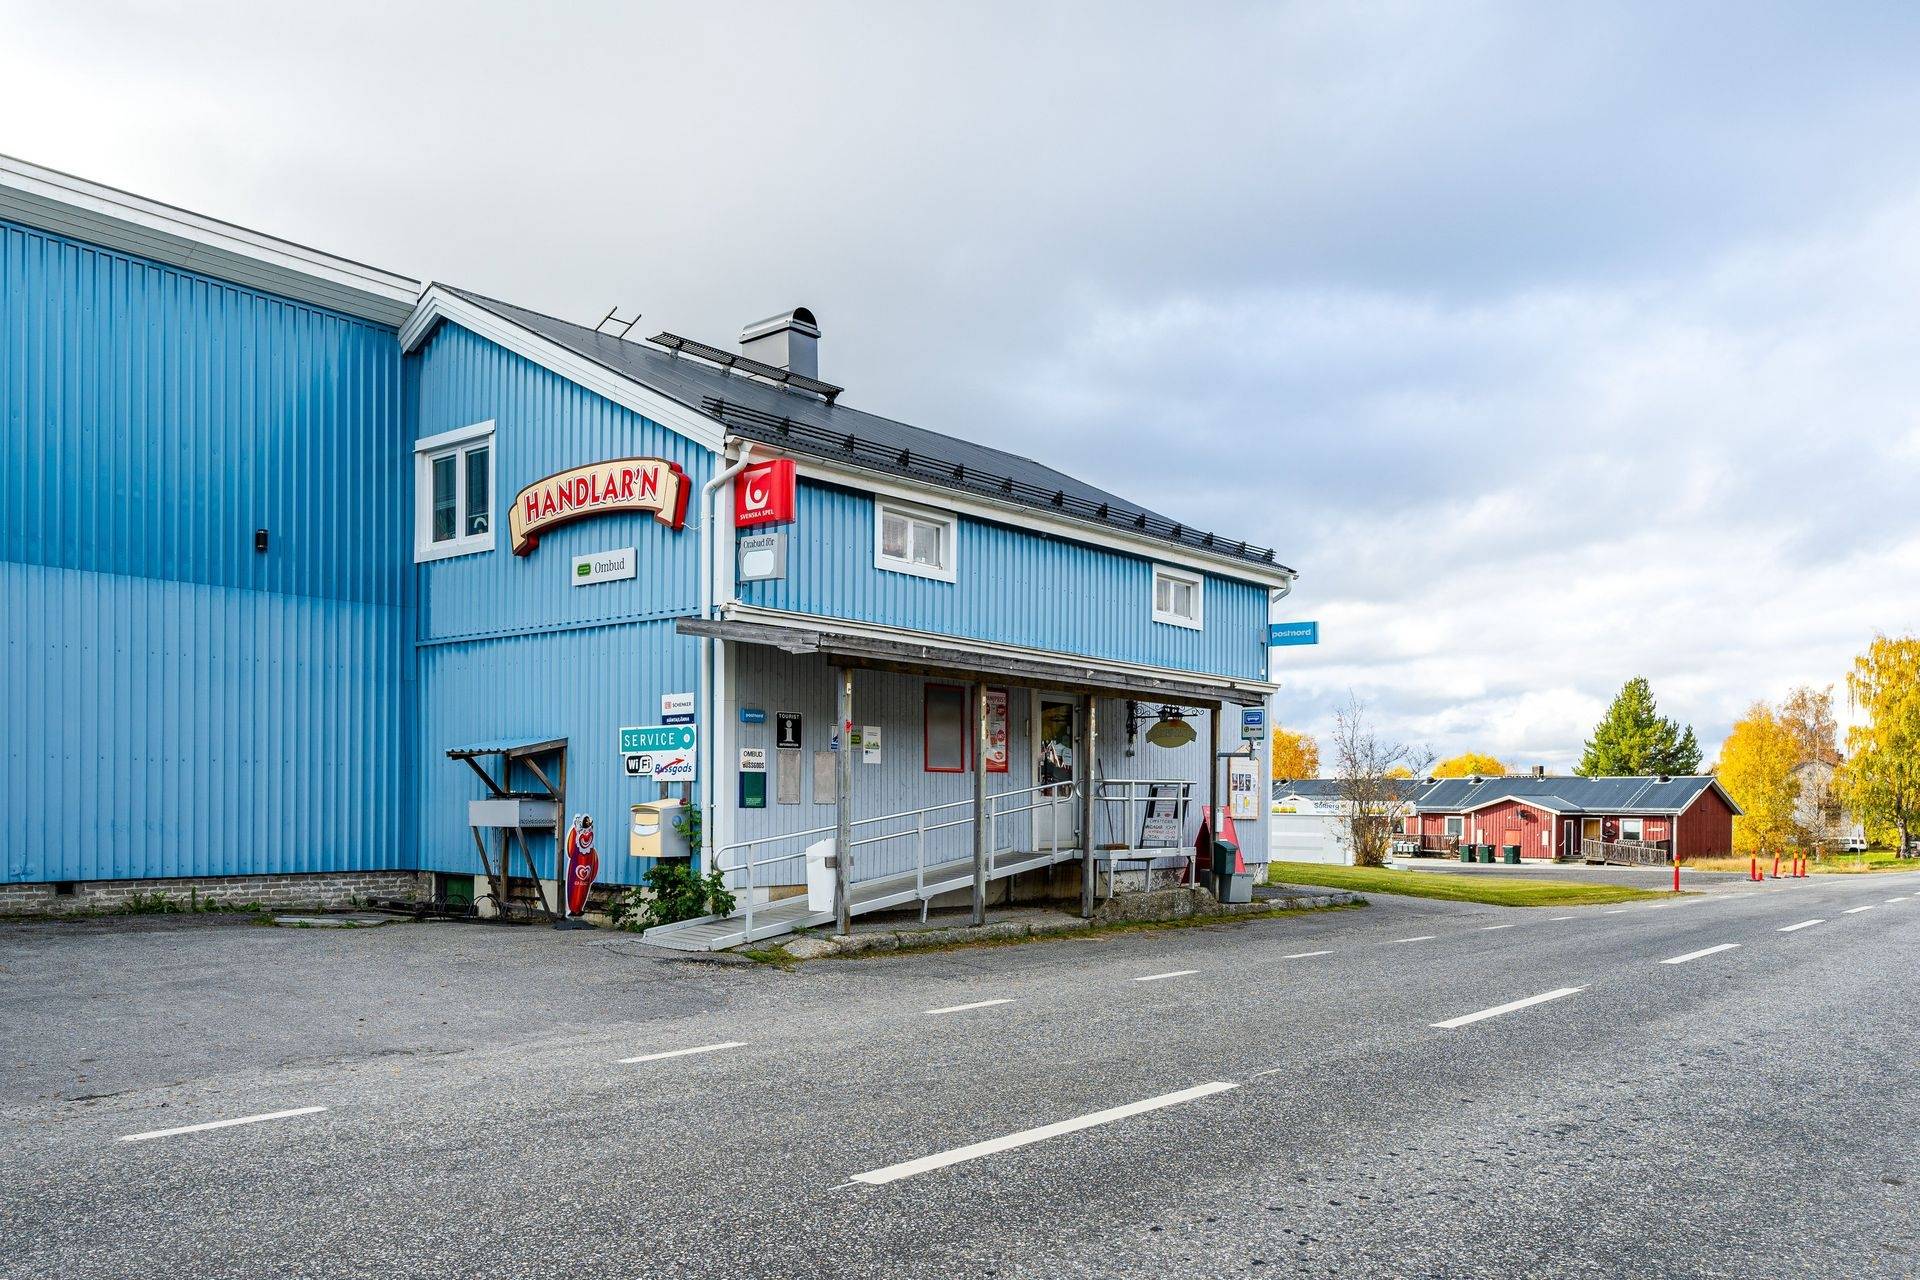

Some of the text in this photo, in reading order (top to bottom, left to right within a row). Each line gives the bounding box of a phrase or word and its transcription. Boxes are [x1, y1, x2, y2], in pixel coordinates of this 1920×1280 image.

[524, 465, 659, 525] HANDLAR'N
[740, 512, 762, 521] SVENSKA
[743, 537, 775, 549] Ombud för
[594, 557, 625, 574] Ombud
[1272, 628, 1312, 638] postnord
[624, 732, 675, 747] SERVICE
[743, 750, 764, 758] OMBUD
[655, 762, 692, 775] Bussgods
